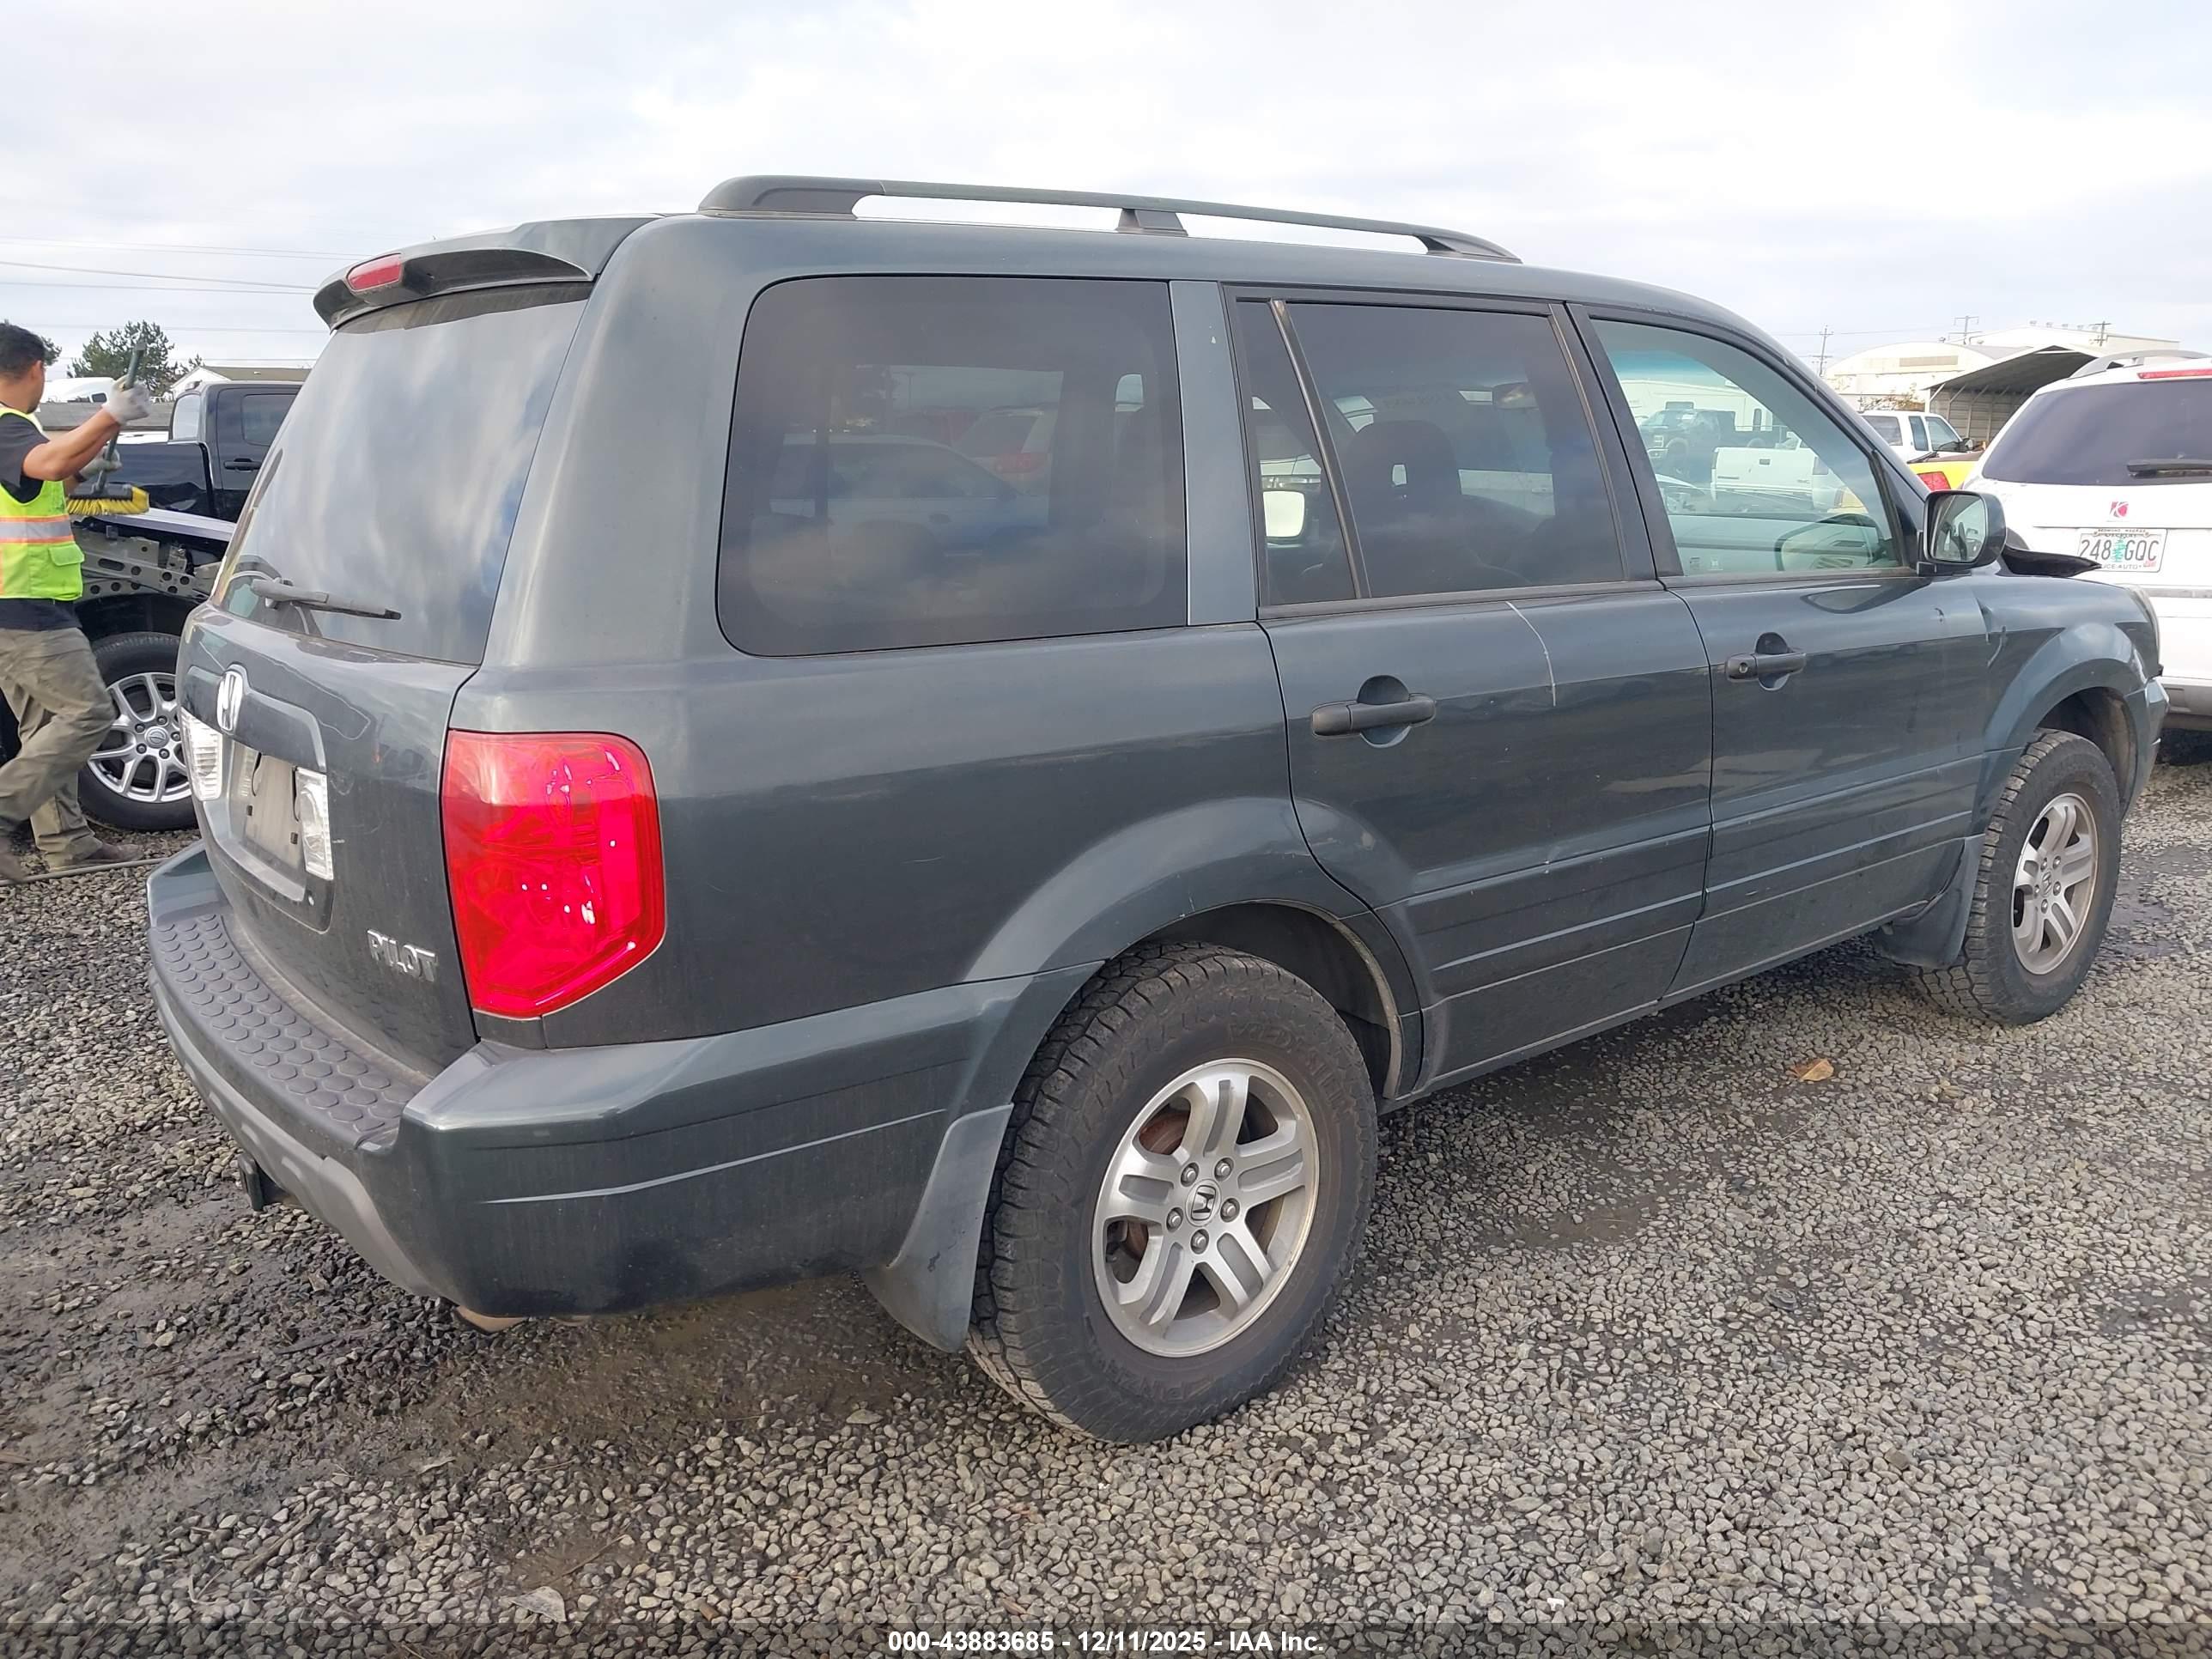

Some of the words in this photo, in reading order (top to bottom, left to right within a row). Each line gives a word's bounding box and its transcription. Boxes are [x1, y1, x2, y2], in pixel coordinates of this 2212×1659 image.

[2079, 538, 2112, 561] 248
[2124, 539, 2160, 562] GQC
[367, 929, 439, 983] PILOT
